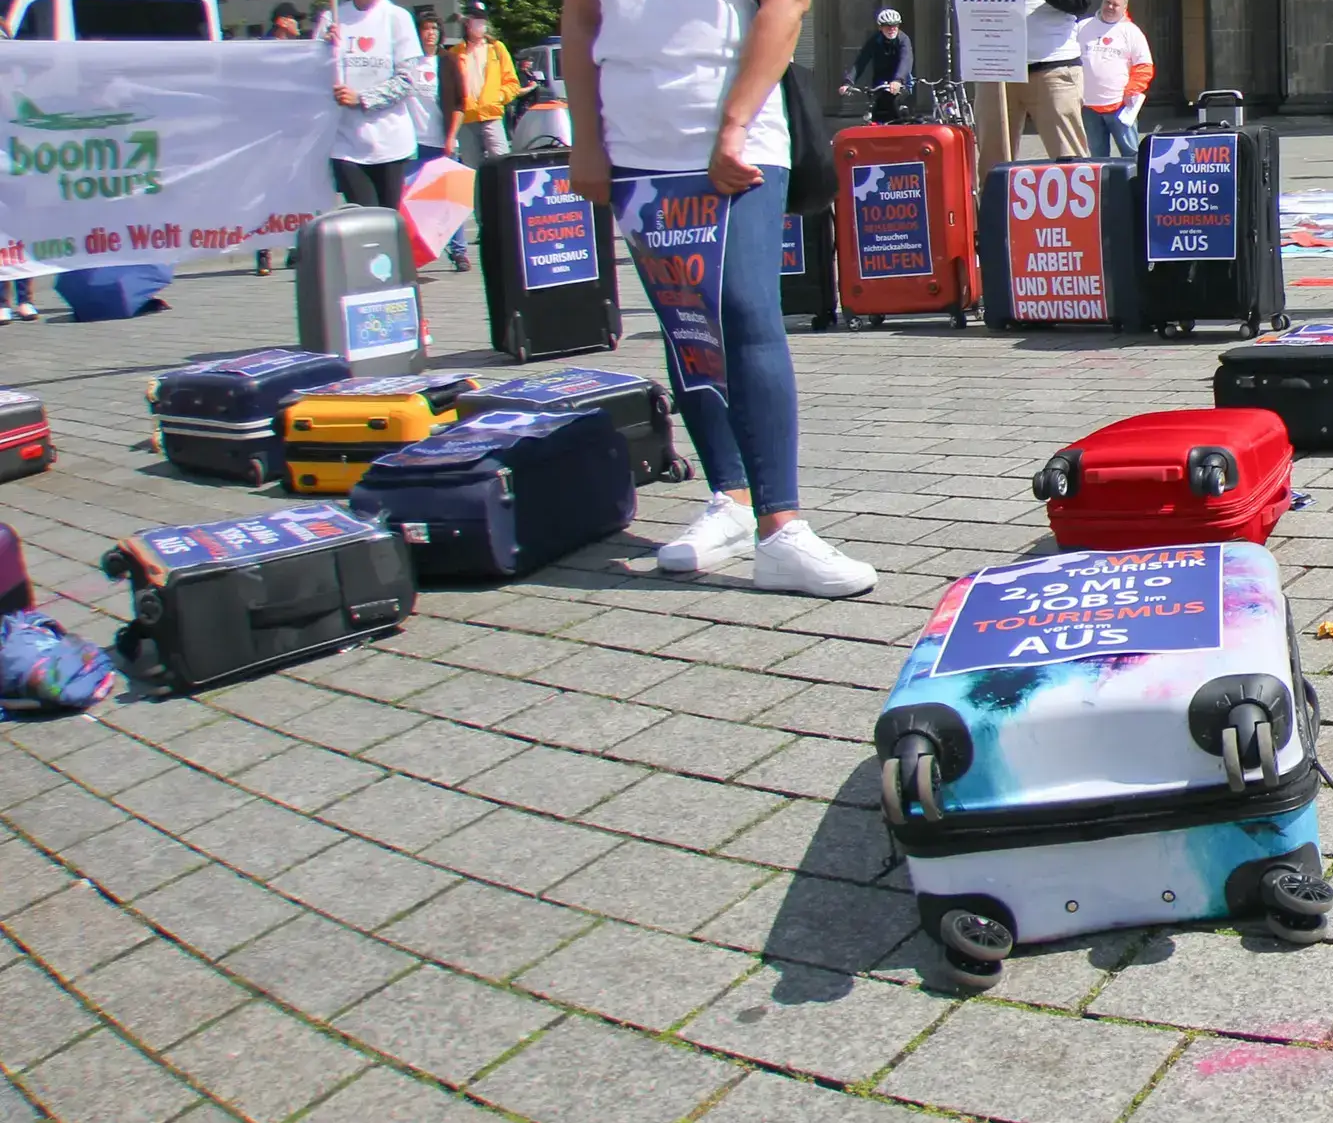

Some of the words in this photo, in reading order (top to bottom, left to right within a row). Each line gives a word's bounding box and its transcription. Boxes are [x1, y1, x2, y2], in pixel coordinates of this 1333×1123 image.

[9, 134, 120, 175] boom
[1194, 145, 1231, 164] WIR
[1180, 163, 1231, 174] TOURISTIK
[58, 170, 162, 201] tours
[888, 174, 920, 191] WIR
[1160, 180, 1185, 197] 2,9
[879, 189, 922, 201] TOURISTIK
[1012, 165, 1096, 221] SOS
[658, 193, 719, 230] WIR
[861, 202, 918, 223] 10.000
[1168, 197, 1210, 212] JOBS
[528, 210, 583, 227] BRANCHEN
[1155, 214, 1232, 227] TOURISMUS
[32, 235, 76, 262] uns
[84, 227, 122, 255] die
[127, 222, 183, 250] Welt
[528, 224, 585, 244] LÖSUNG
[645, 225, 718, 250] TOURISTIK
[875, 232, 909, 242] brauchen
[1035, 227, 1072, 248] VIEL
[1170, 235, 1209, 252] AUS
[863, 241, 923, 253] nichtrückzahlbare
[531, 249, 589, 266] TOURISMUS
[864, 251, 925, 271] HILFEN
[1026, 251, 1084, 272] ARBEIT
[1015, 276, 1047, 296] UND
[1051, 275, 1101, 296] KEINE
[1017, 299, 1103, 320] PROVISION
[1064, 558, 1207, 578] TOURISTIK
[1105, 549, 1206, 567] WIR
[999, 582, 1070, 602] 2,9
[1018, 589, 1141, 615] JOBS
[973, 600, 1206, 634] TOURISMUS
[1043, 624, 1071, 635] vor
[1073, 622, 1113, 632] dem
[1008, 627, 1130, 658] AUS
